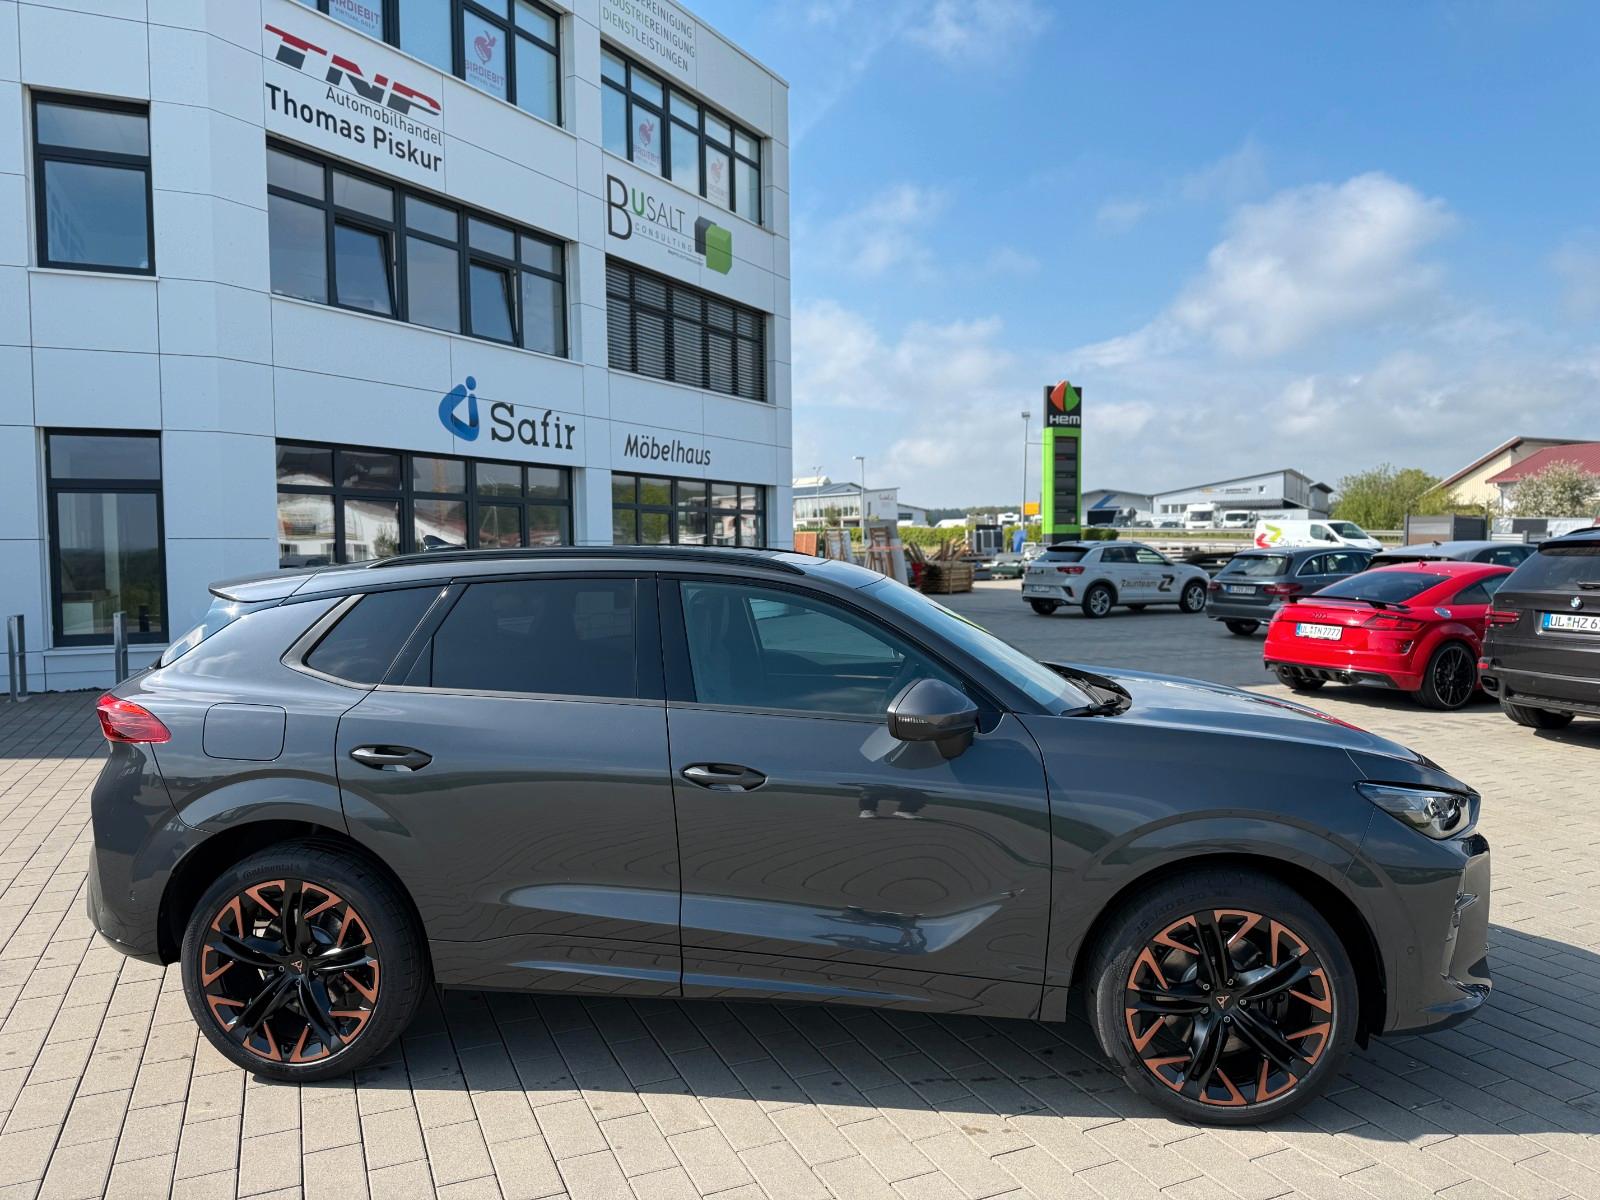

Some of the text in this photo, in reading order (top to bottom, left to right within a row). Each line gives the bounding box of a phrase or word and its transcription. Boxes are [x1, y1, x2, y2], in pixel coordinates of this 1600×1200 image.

[330, 0, 380, 24] RDIEBIT
[602, 7, 688, 72] DIENSTLEISTUNGEN
[265, 24, 441, 116] TNP
[265, 82, 443, 172] Thomas Piskur
[326, 86, 442, 146] Automobilhandel
[607, 173, 685, 240] BUSALT
[635, 222, 692, 253] CONSULTING
[490, 402, 576, 450] Safir
[624, 433, 711, 466] Möbelhaus
